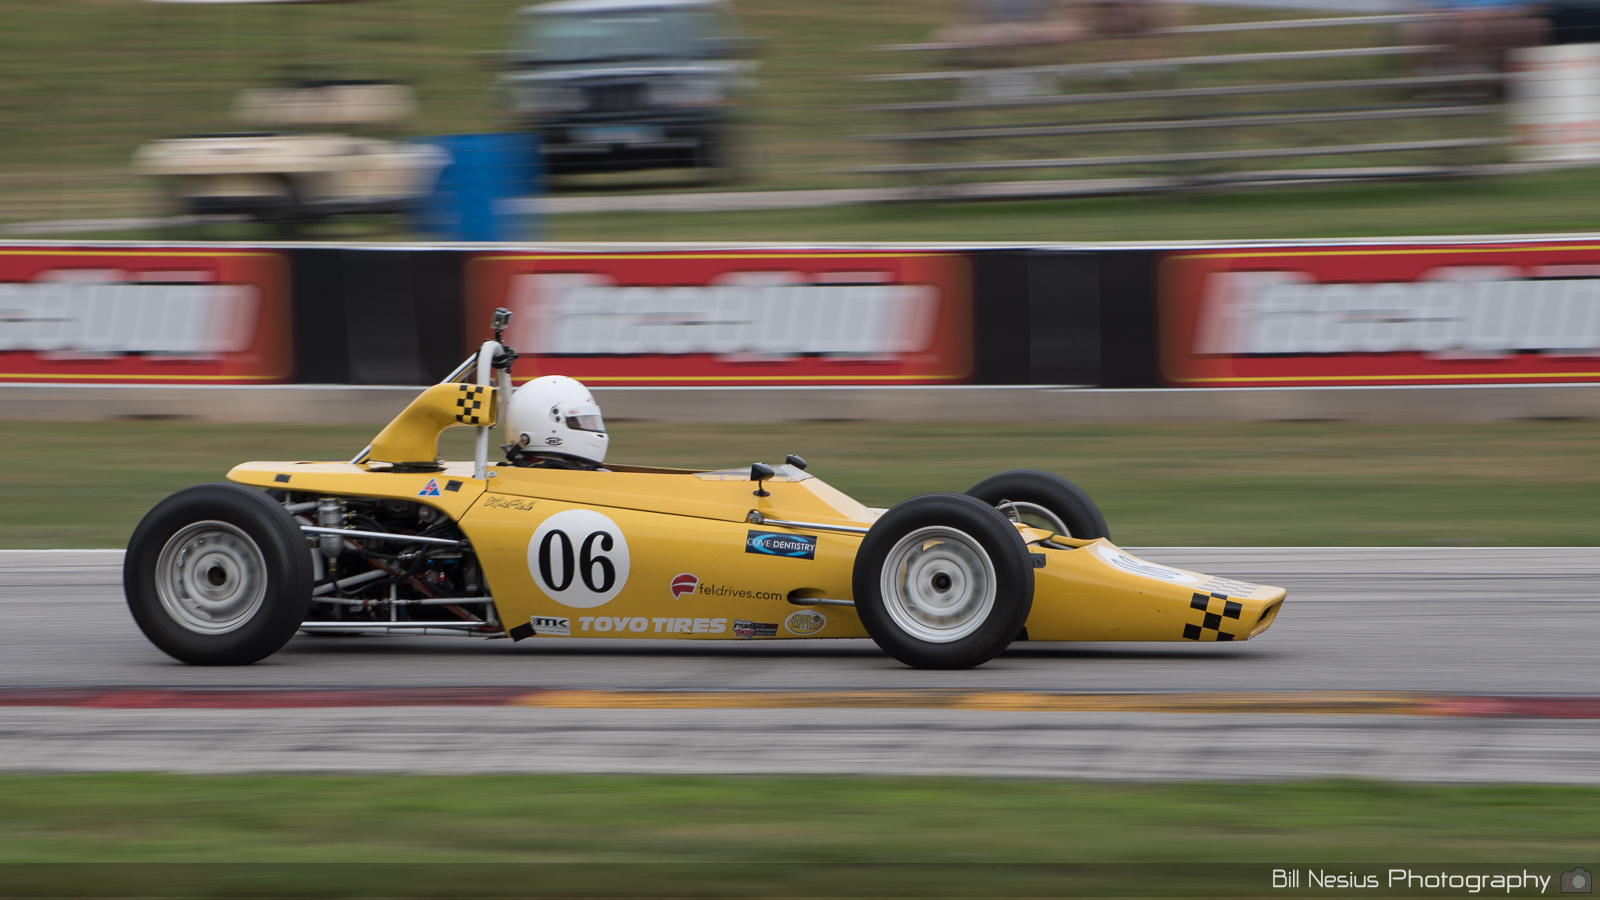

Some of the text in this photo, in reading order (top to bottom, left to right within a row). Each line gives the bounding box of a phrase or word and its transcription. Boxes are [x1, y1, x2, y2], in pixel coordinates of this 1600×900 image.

[746, 538, 816, 552] COVE DENTISTRY
[538, 528, 616, 593] 06
[699, 583, 783, 601] feldrives.com
[579, 616, 649, 633] TOYO
[651, 617, 727, 634] TIRES
